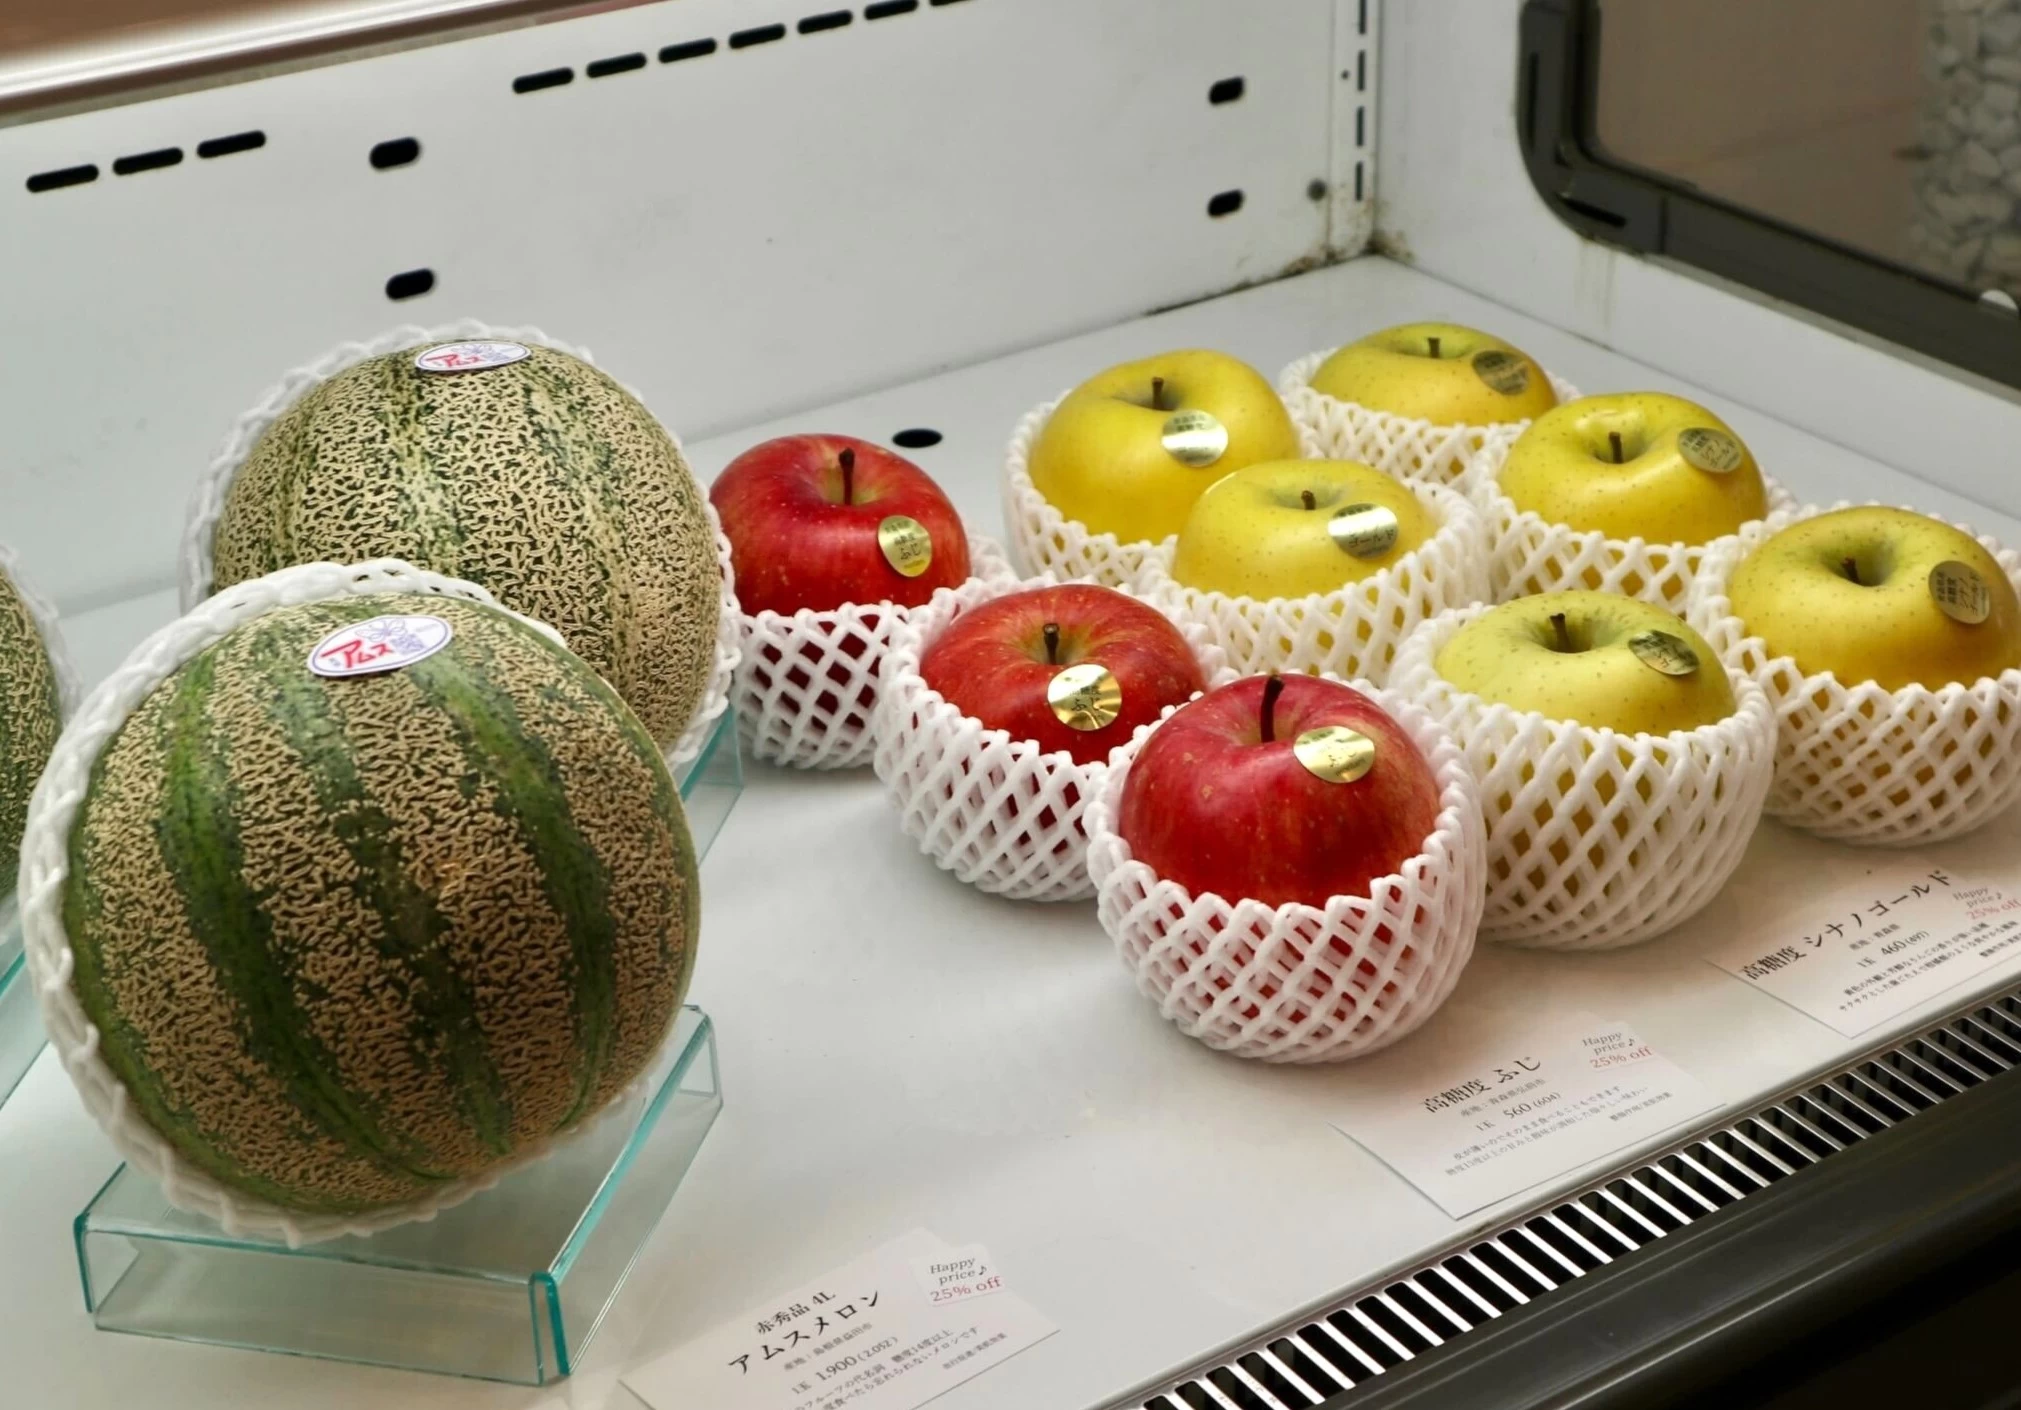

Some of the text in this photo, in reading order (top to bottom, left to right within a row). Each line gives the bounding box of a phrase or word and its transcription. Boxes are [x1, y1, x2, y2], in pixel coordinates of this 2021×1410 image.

[1804, 869, 1950, 948] シナノゴールド
[1582, 1032, 1622, 1046] Happy
[1590, 1046, 1652, 1068] 25% off
[1493, 1056, 1541, 1084] ふじ
[930, 1258, 975, 1274] Happy
[939, 1270, 975, 1286] price
[930, 1276, 1001, 1301] 25% off
[756, 1291, 837, 1336] 赤秀品 4L
[729, 1291, 880, 1375] アムスメロン
